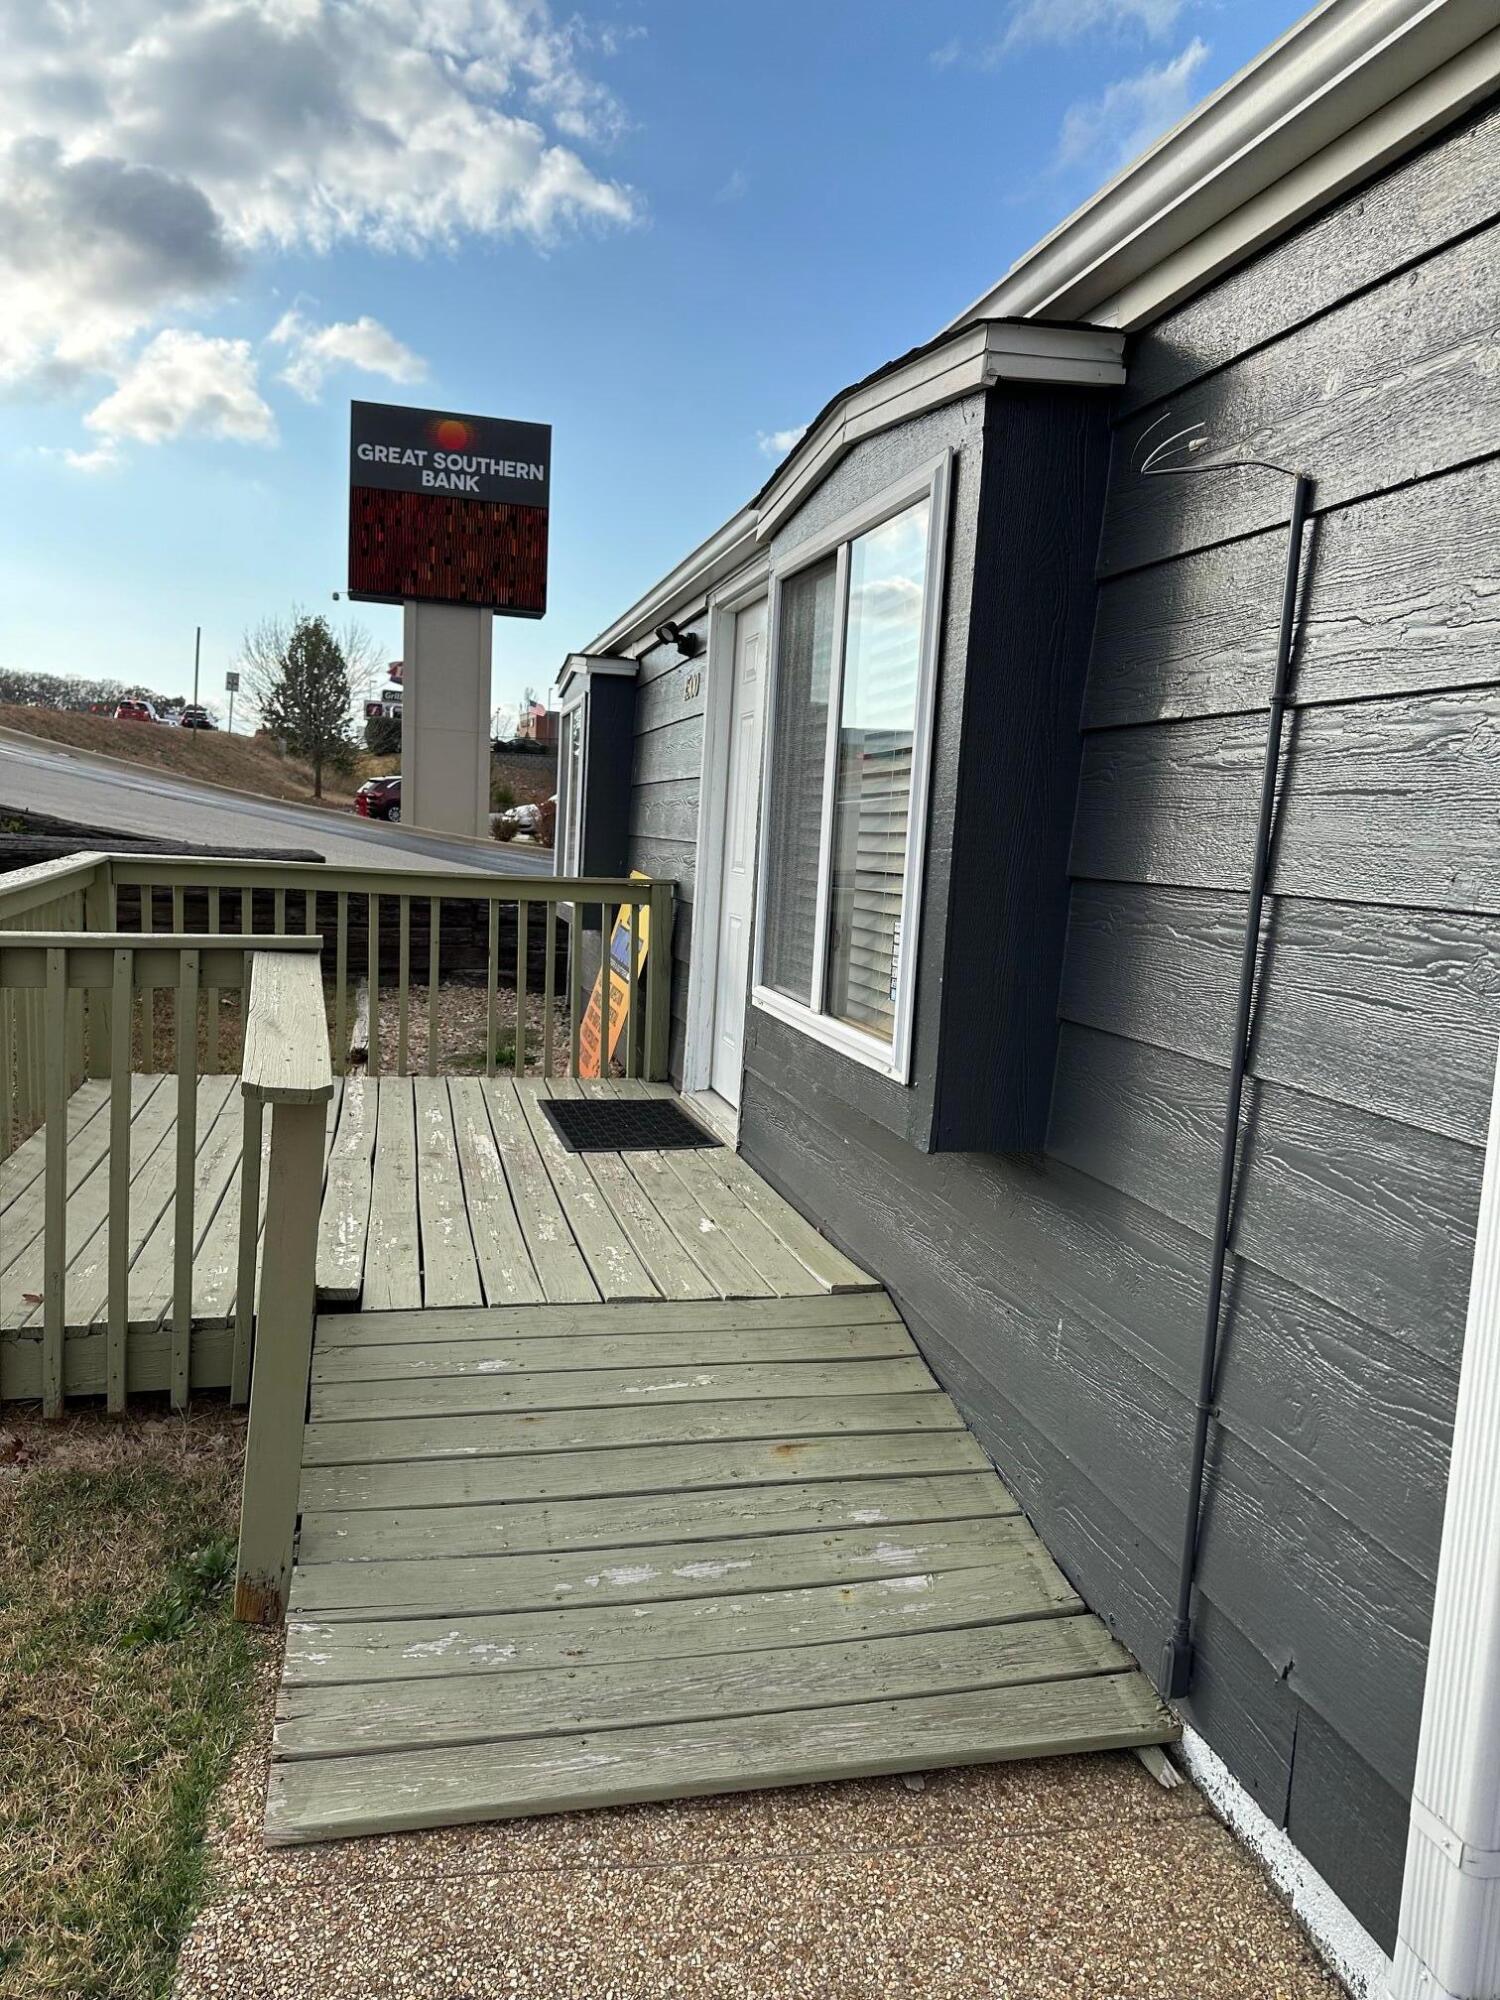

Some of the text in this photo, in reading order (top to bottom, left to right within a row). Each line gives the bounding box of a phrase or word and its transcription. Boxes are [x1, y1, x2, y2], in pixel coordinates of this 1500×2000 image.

[357, 443, 544, 481] GREAT SOUTHERN
[421, 470, 480, 493] BANK
